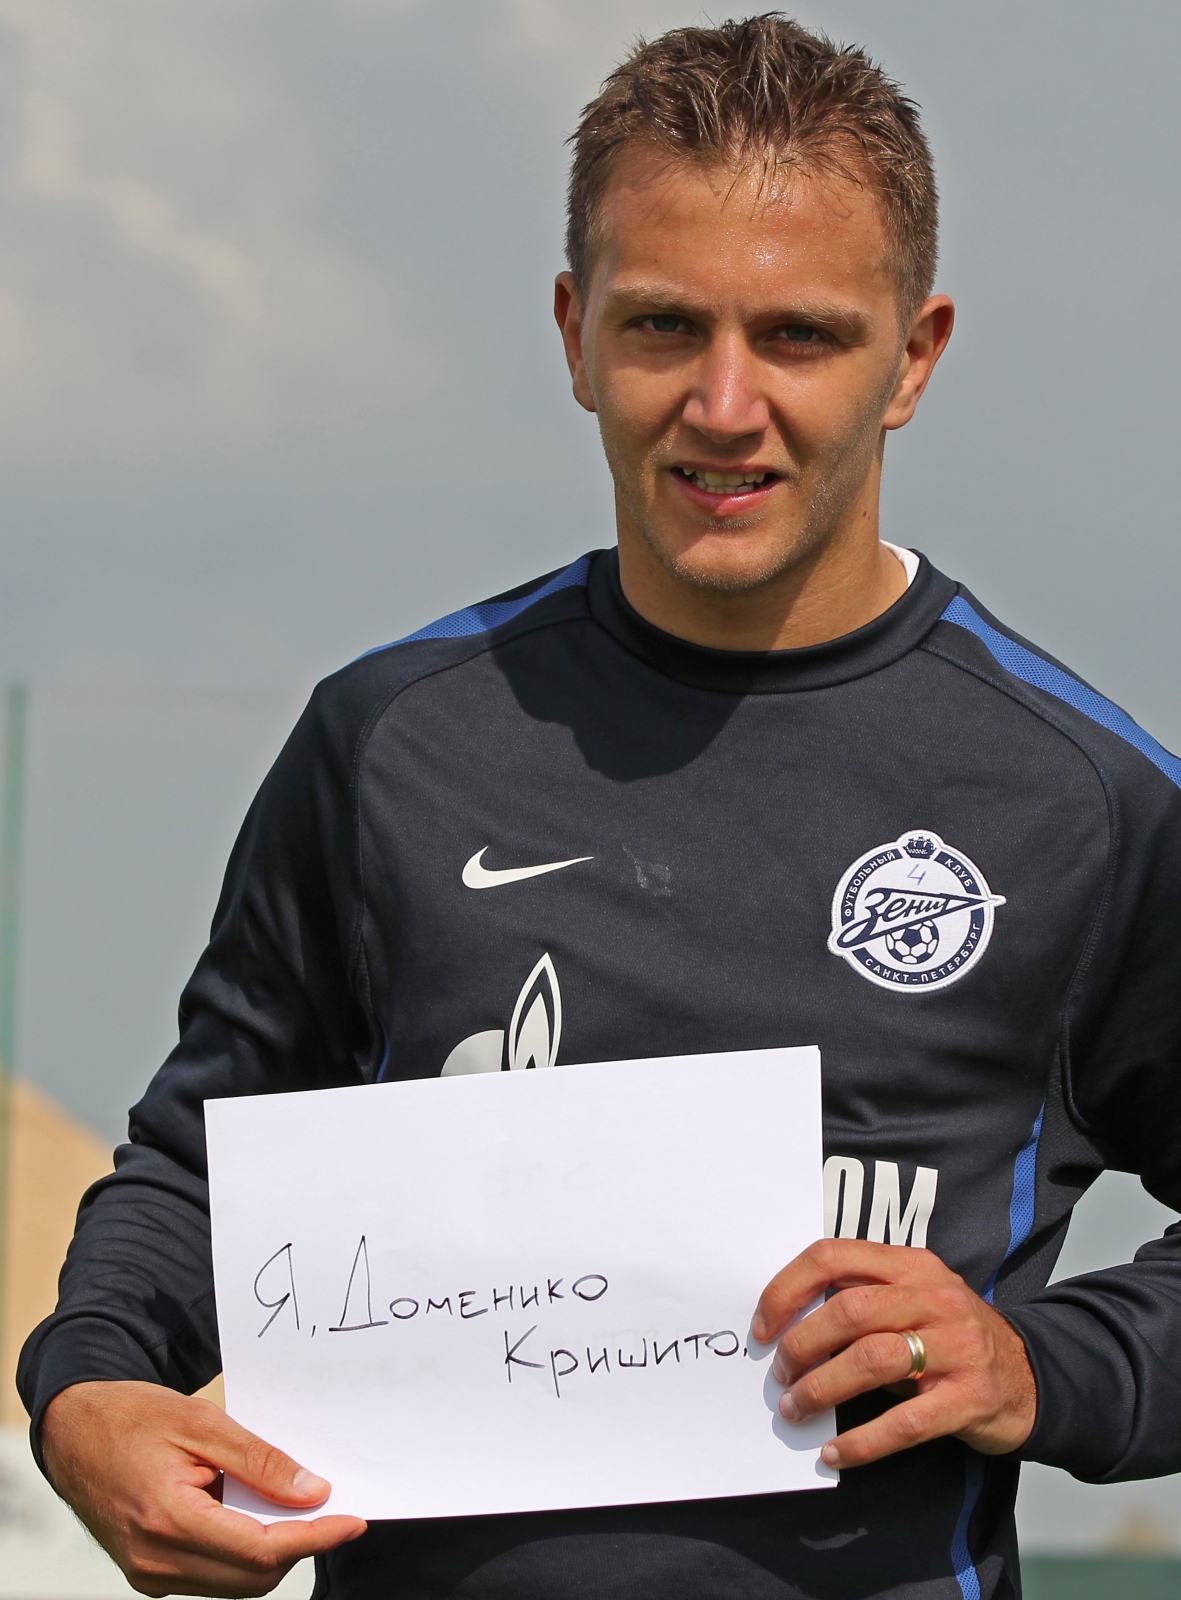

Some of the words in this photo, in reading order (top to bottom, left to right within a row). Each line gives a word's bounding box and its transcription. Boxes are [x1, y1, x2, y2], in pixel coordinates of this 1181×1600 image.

[844, 850, 896, 918] ФУТБОЛЬНЫЙ
[944, 858, 973, 888] КЛУБ
[907, 863, 927, 886] 4
[864, 923, 981, 983] САНКТ-ПЕТЕРБУРГ
[253, 1242, 316, 1338] Я,
